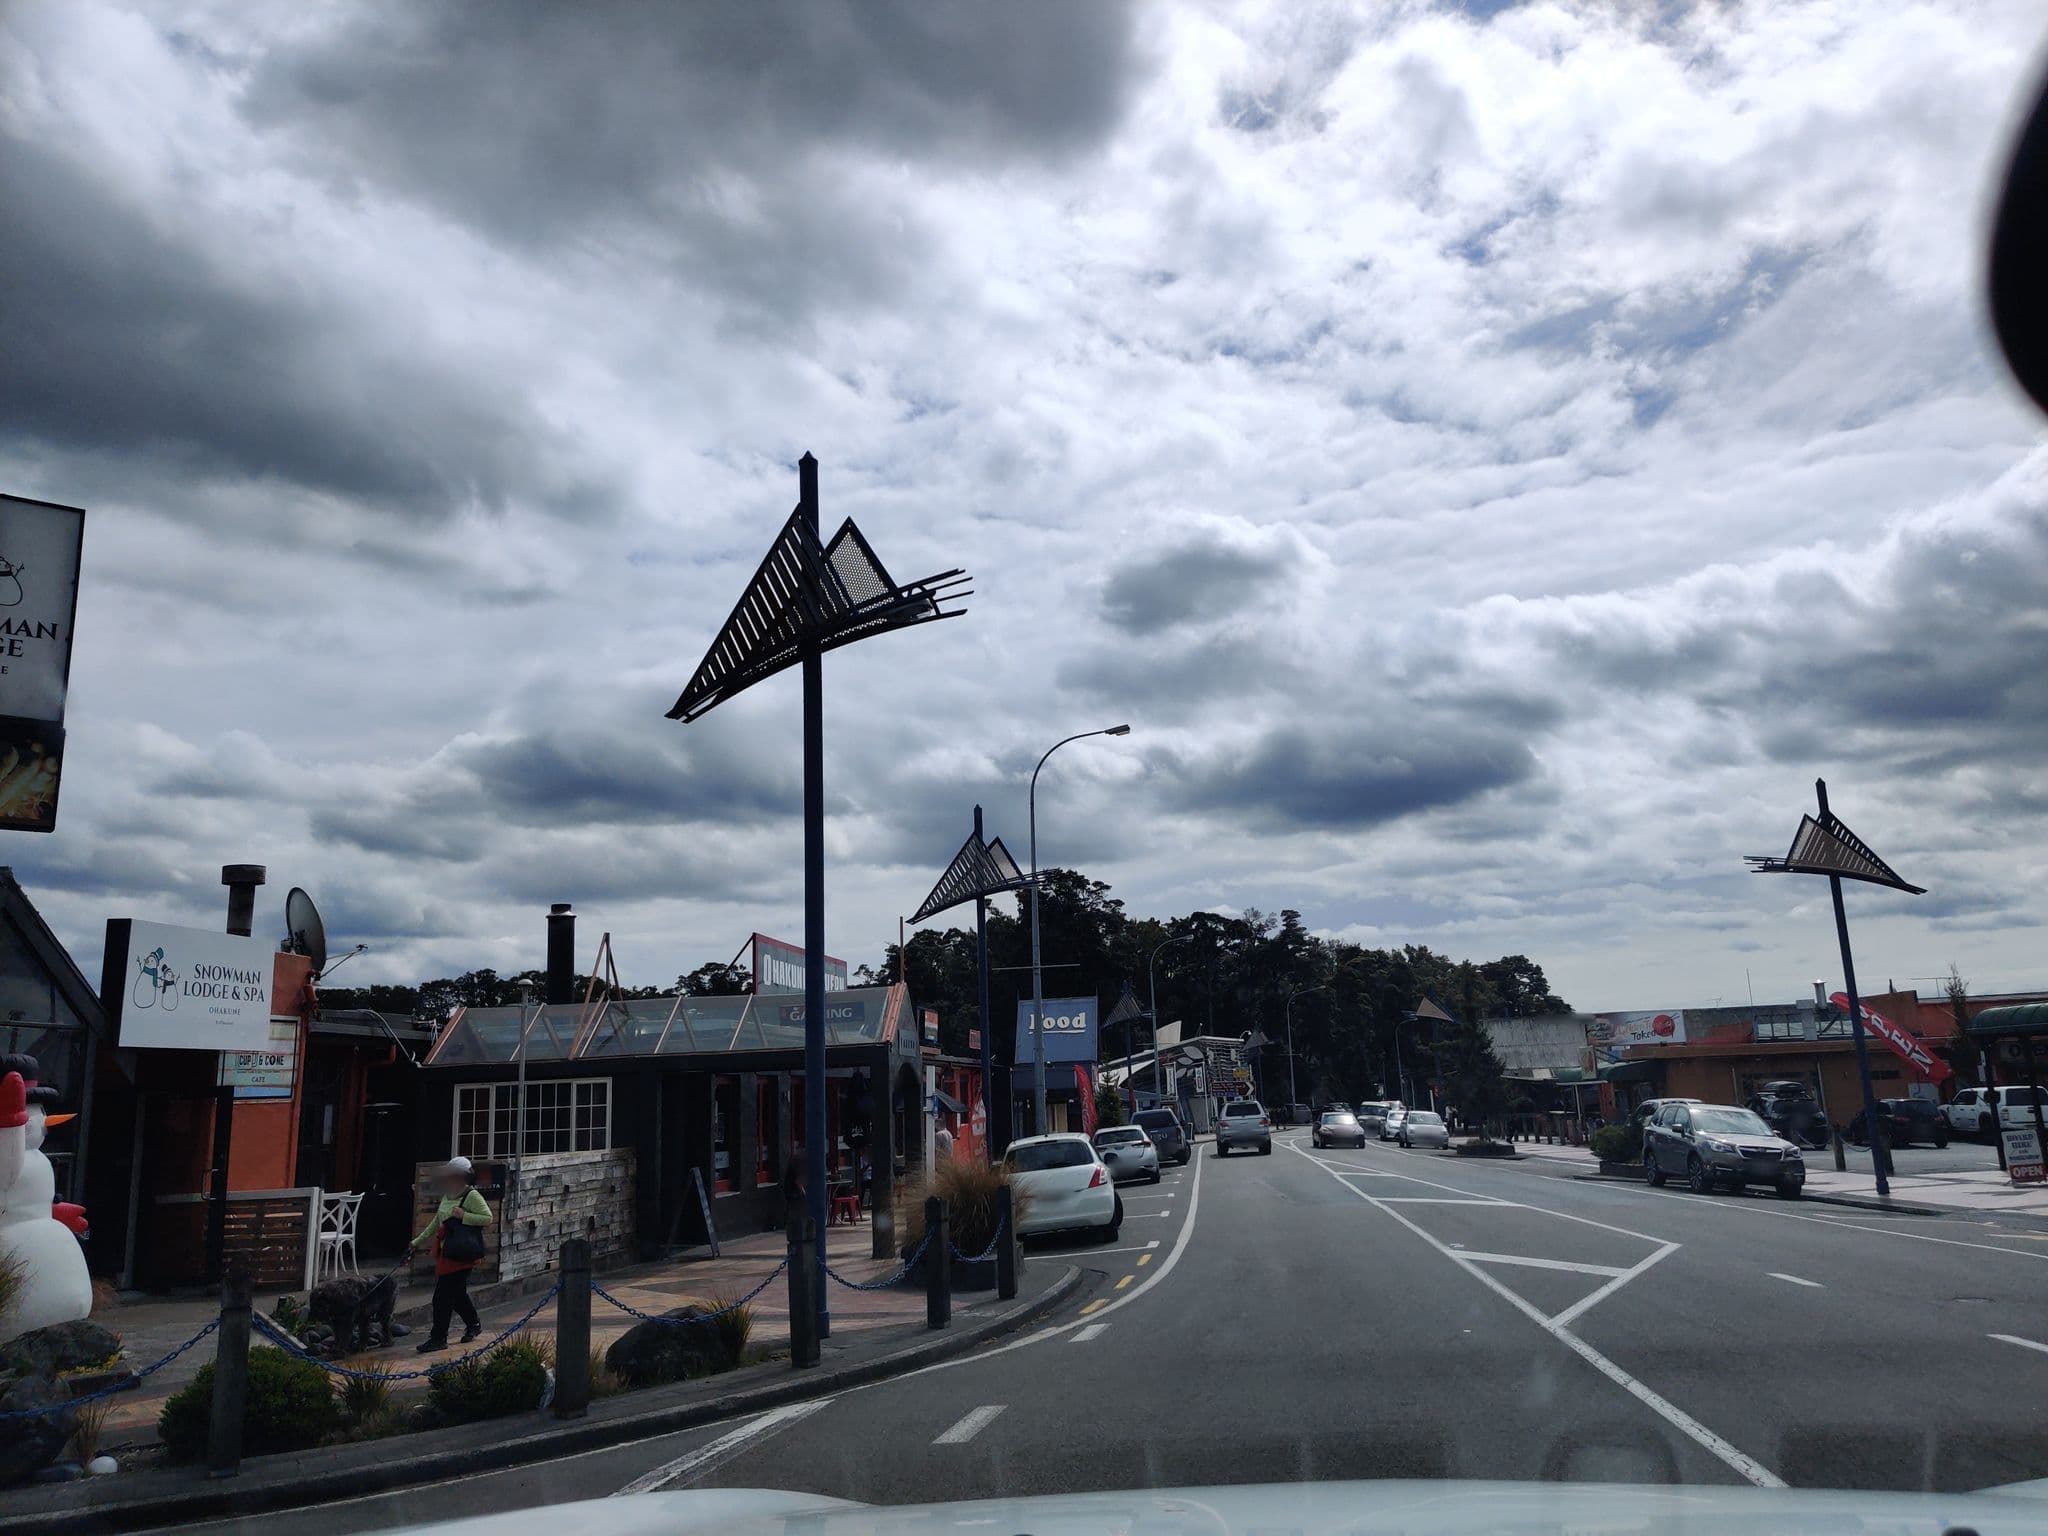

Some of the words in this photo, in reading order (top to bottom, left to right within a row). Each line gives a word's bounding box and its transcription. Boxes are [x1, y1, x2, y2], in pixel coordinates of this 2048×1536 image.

[194, 963, 261, 984] SNOWMAN
[184, 981, 229, 999] LODGE
[231, 985, 241, 1001] &
[243, 986, 264, 1002] SPA
[208, 1006, 241, 1016] OHAKUNE
[2013, 1165, 2044, 1177] OPEN
